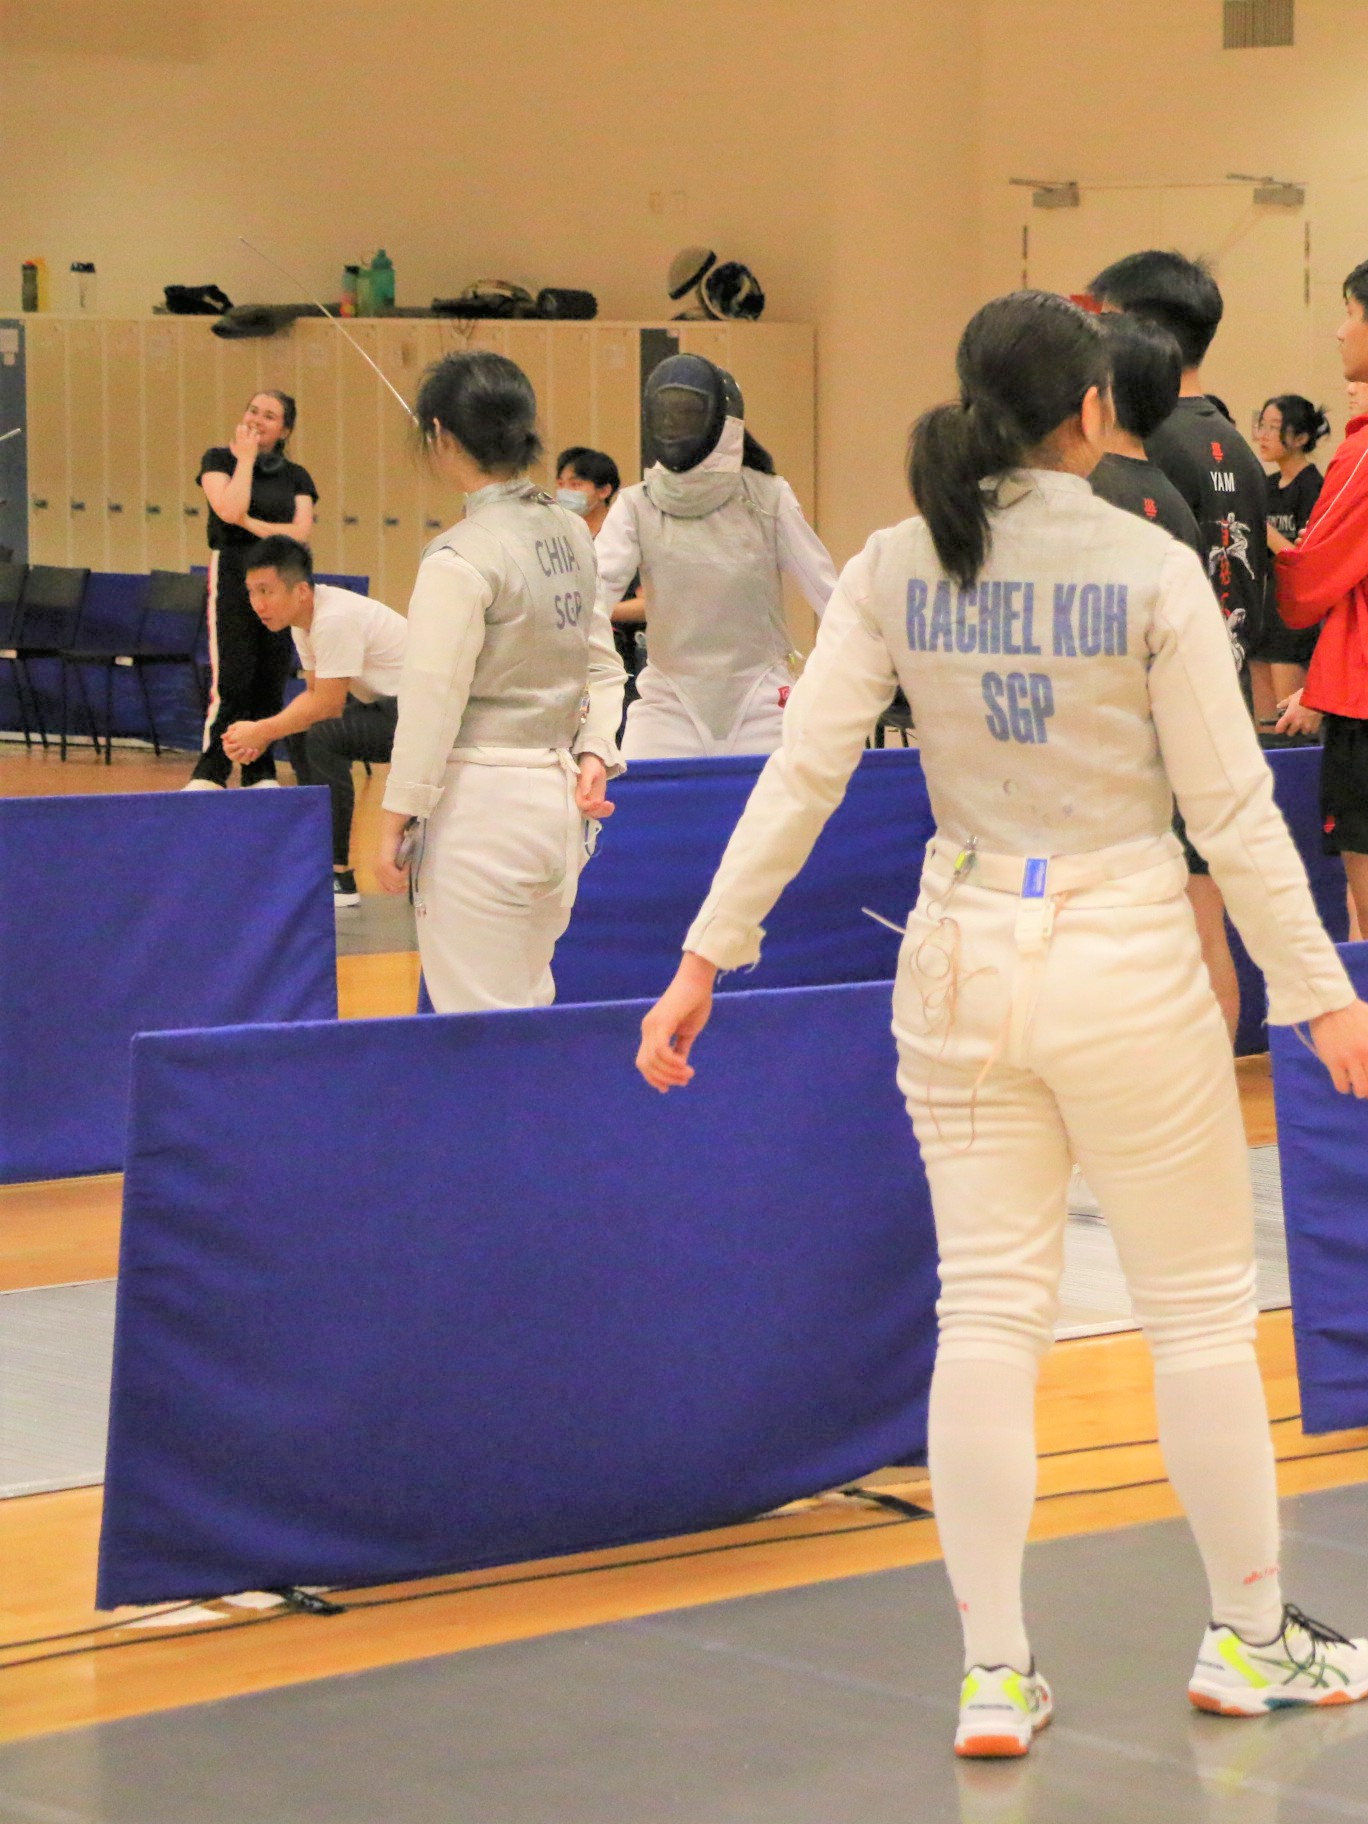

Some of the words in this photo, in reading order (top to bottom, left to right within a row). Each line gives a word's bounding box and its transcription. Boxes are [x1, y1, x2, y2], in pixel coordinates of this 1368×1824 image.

[1210, 471, 1236, 492] YAM
[535, 535, 581, 577] CHIA
[554, 591, 582, 630] SGP
[906, 578, 1042, 656] RACHEL
[1052, 583, 1128, 657] KOH
[981, 671, 1055, 744] SGP
